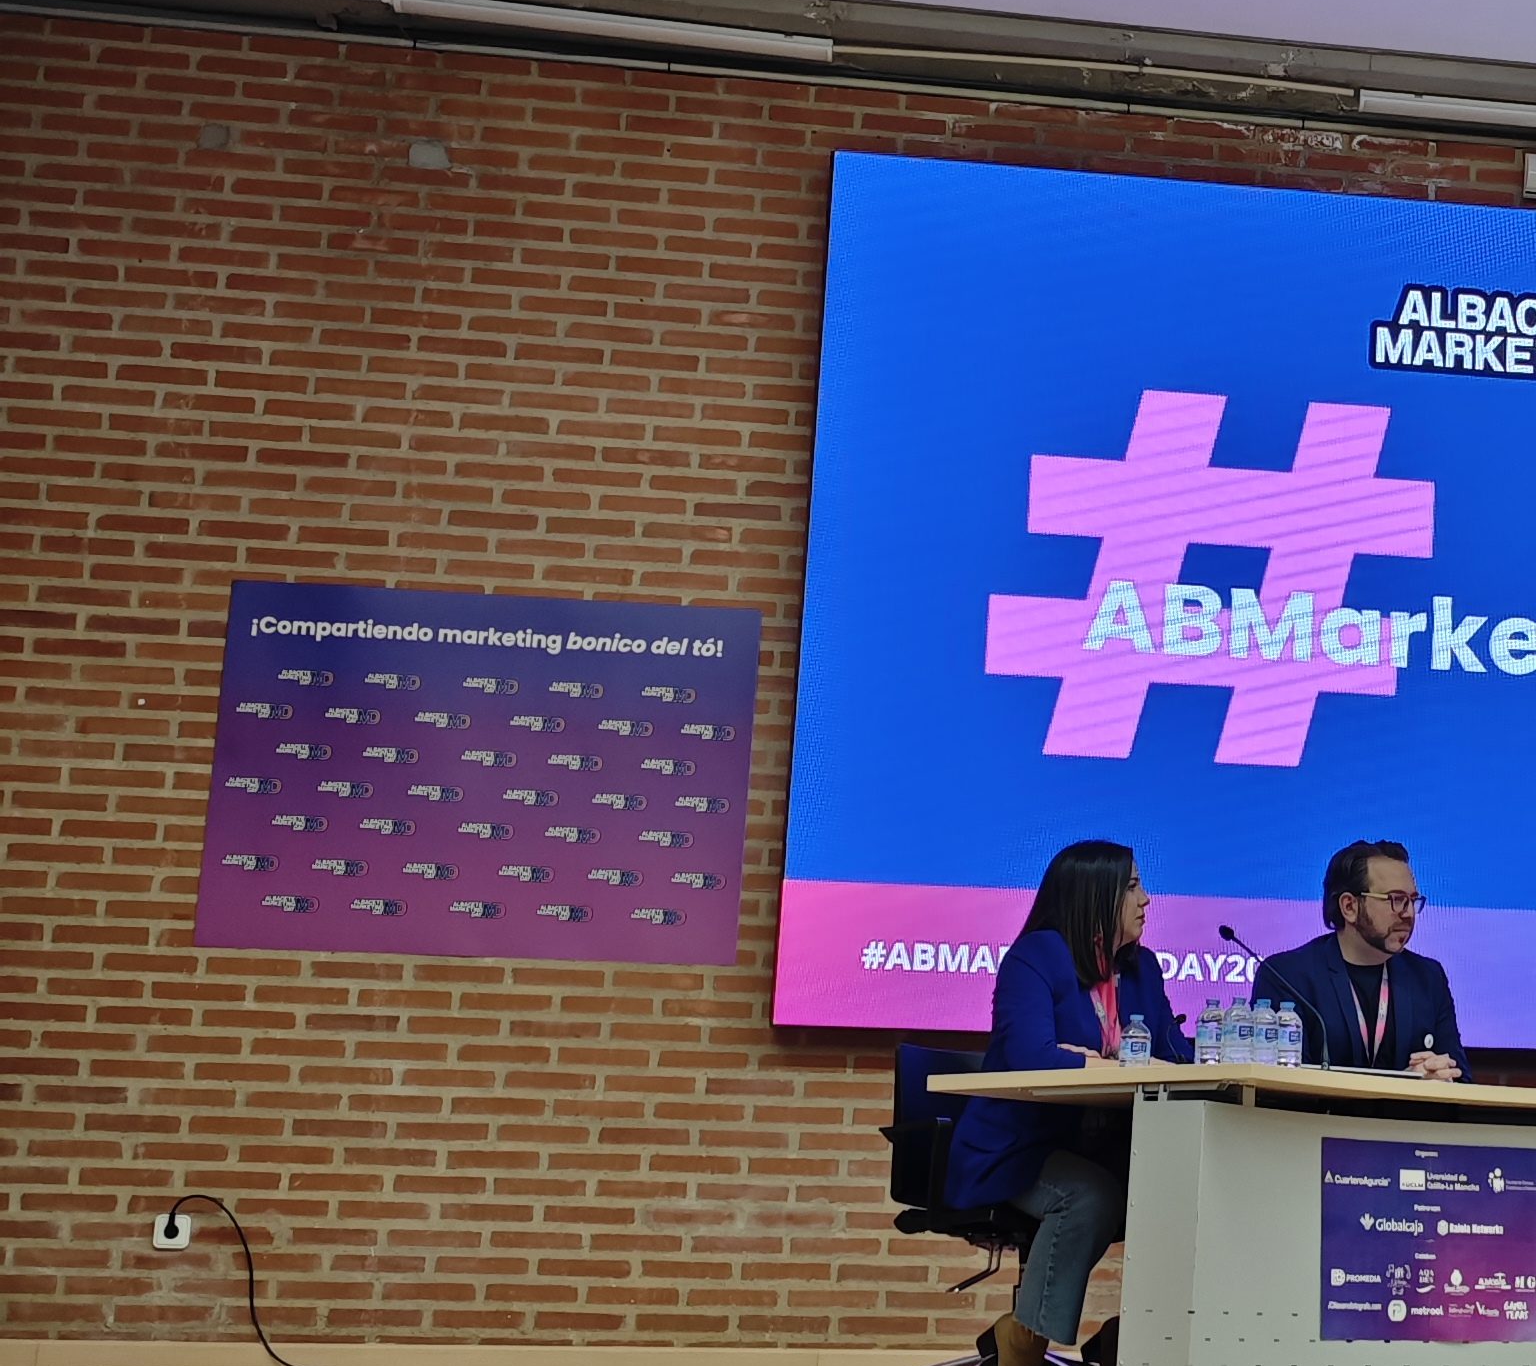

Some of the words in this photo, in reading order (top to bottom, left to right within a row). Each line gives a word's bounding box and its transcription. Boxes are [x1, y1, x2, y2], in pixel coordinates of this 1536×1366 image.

[250, 615, 433, 643] ¡Compartiendo
[437, 626, 562, 654] marketing
[566, 632, 646, 655] bonico
[651, 636, 687, 657] del
[692, 638, 724, 659] tó!
[1375, 1218, 1424, 1236] Globalcaja
